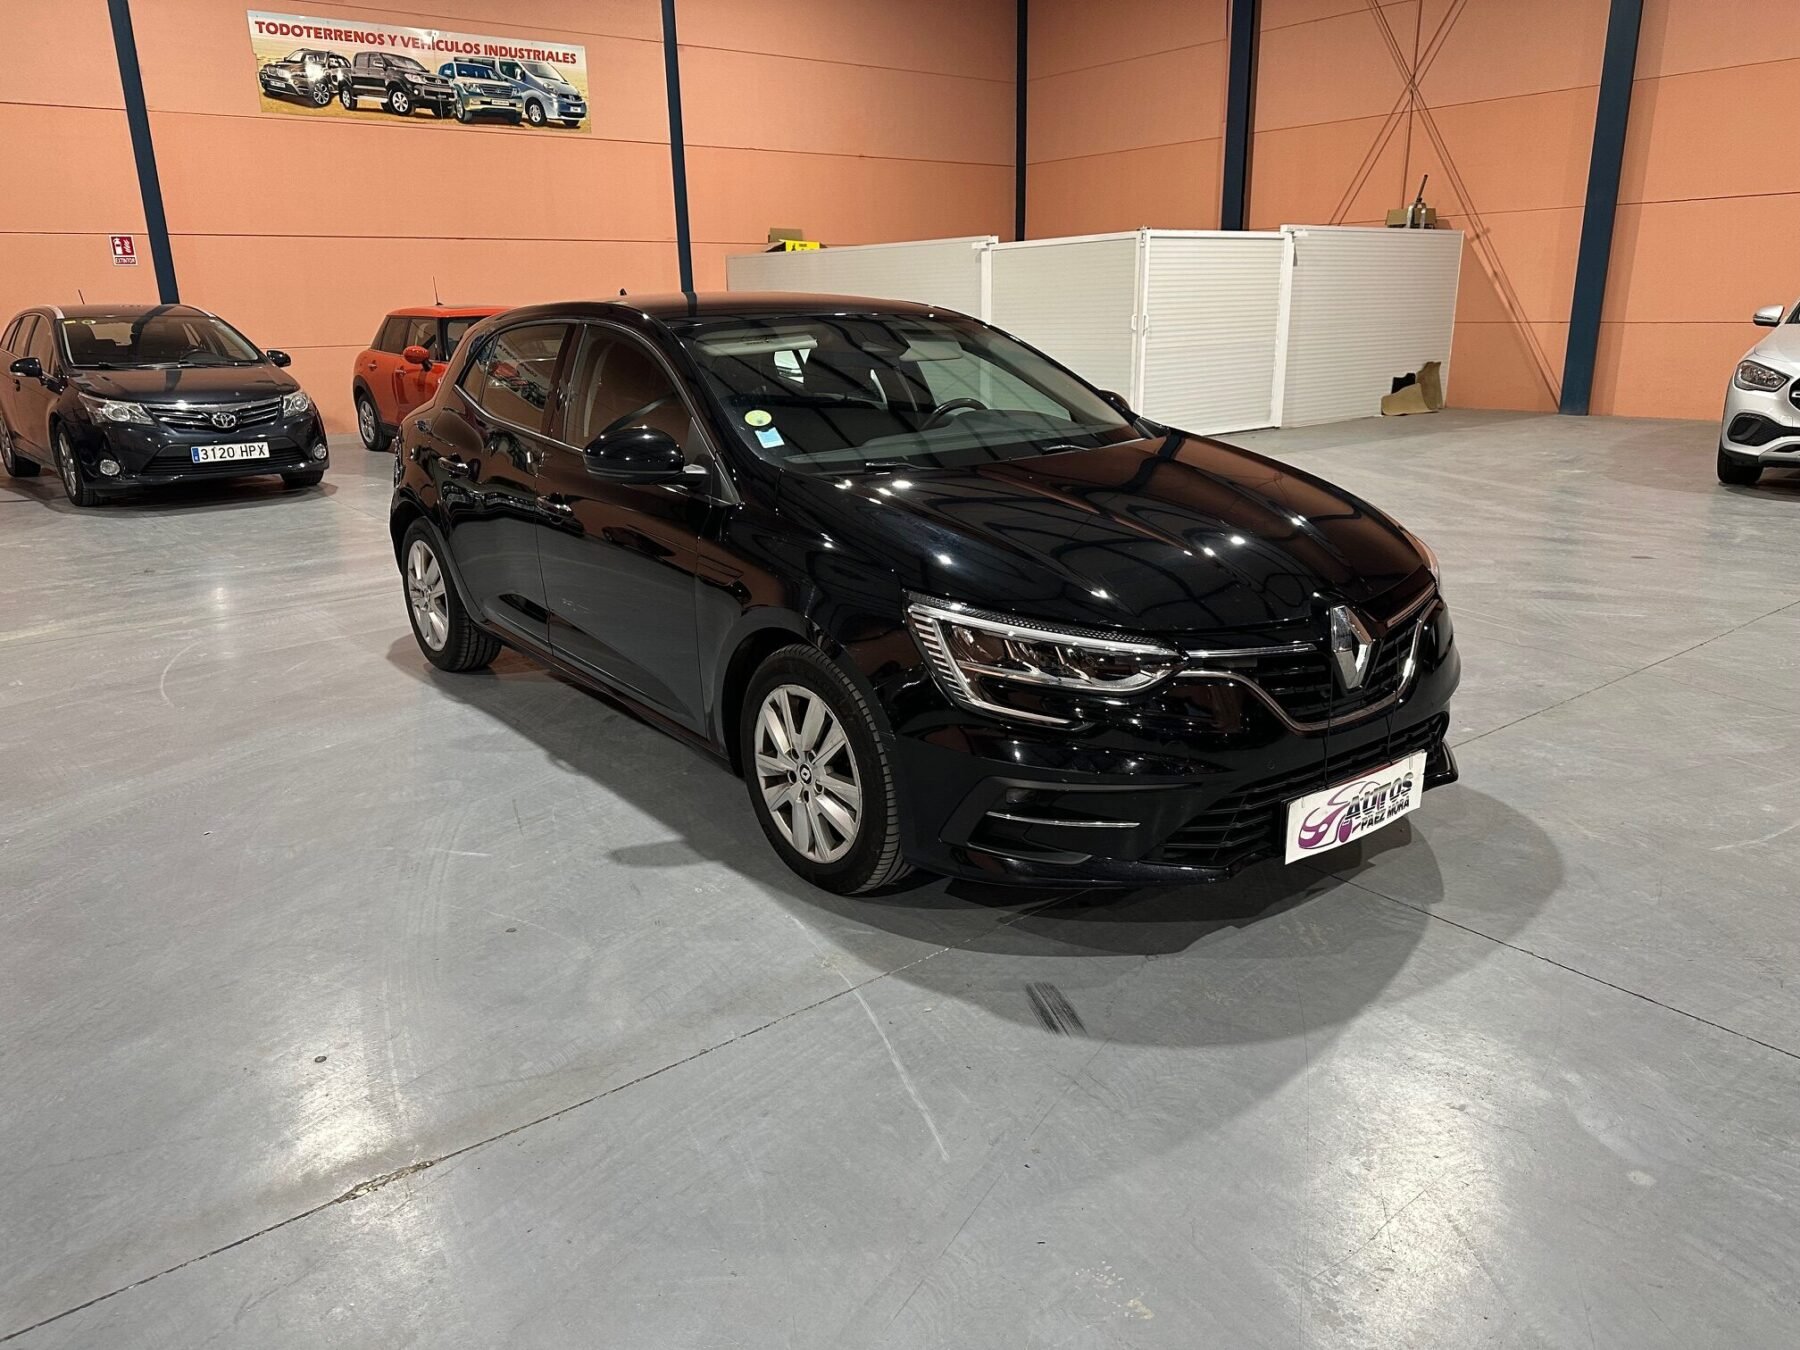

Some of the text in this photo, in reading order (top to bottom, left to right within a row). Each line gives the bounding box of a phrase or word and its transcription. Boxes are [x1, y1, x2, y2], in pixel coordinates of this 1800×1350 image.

[254, 20, 385, 45] TODOTERRENOS
[387, 34, 397, 47] Y
[484, 44, 577, 64] INDUSTRIALES
[201, 444, 266, 460] 3120 HPX
[1345, 772, 1413, 821] AUTOS
